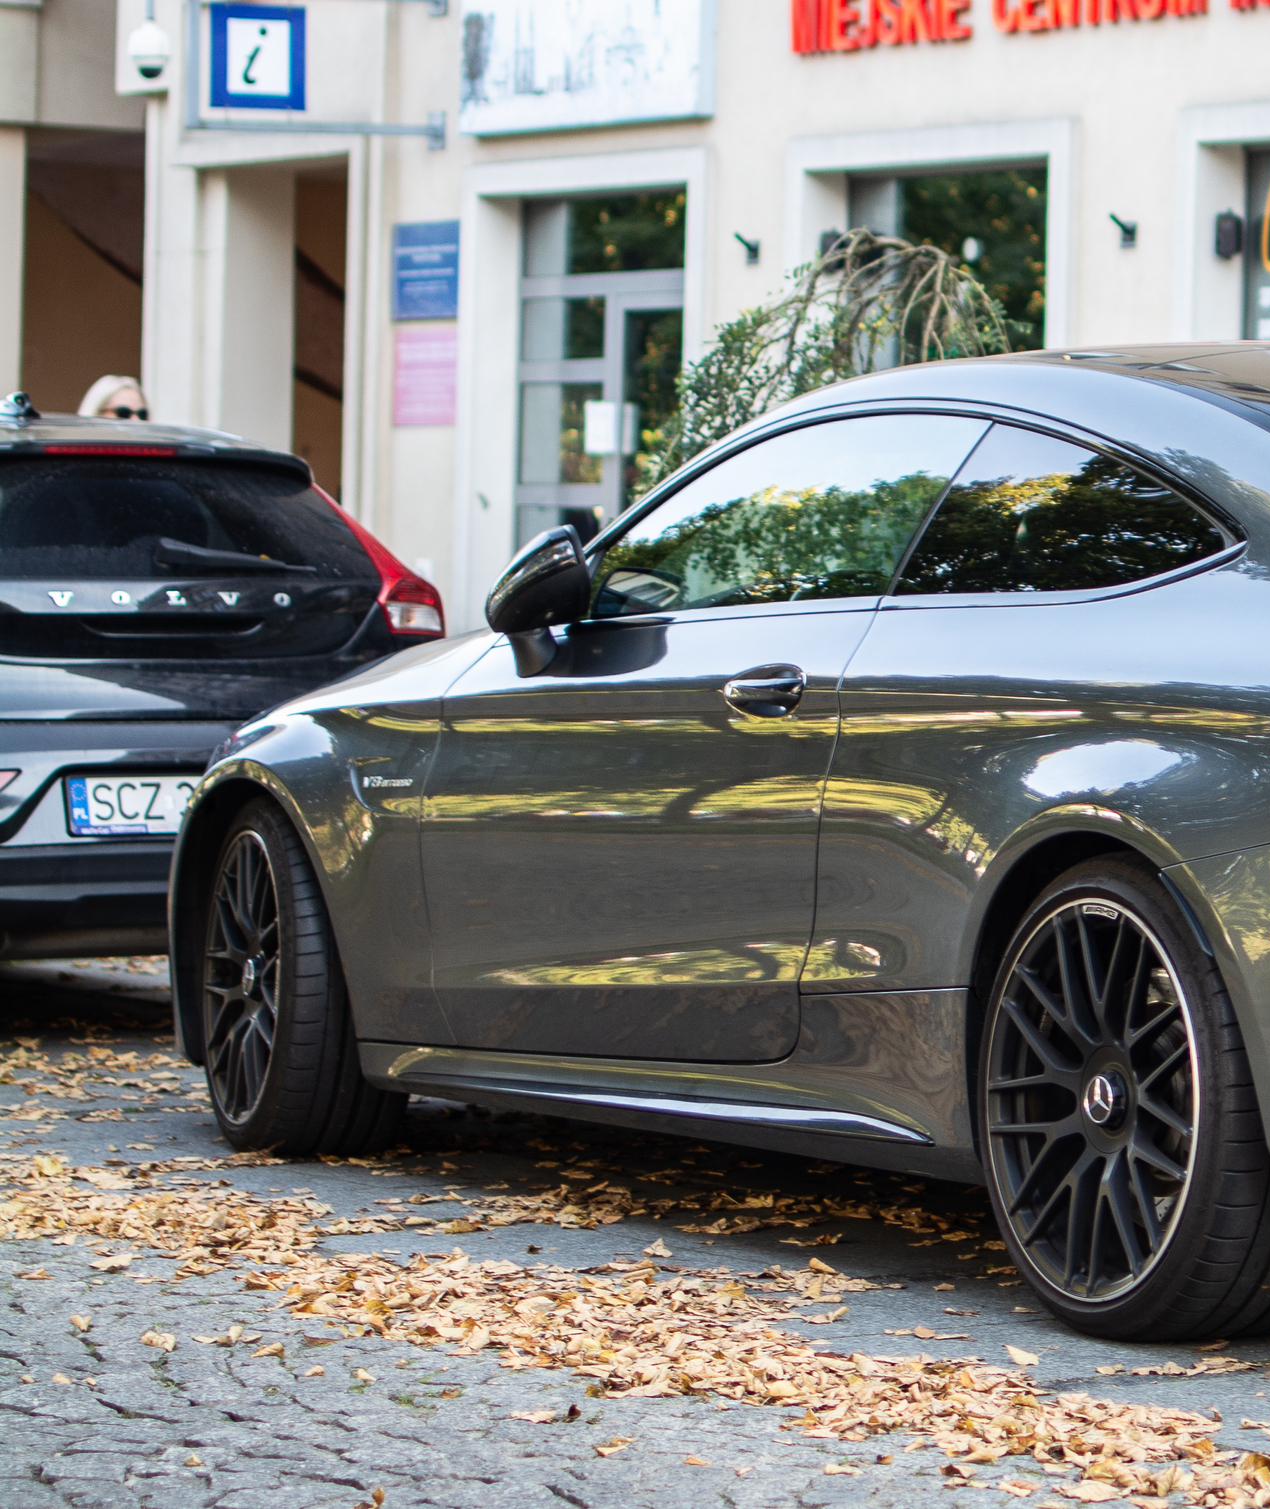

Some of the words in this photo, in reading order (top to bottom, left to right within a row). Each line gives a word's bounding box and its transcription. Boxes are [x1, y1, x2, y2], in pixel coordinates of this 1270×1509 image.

[790, 0, 972, 53] MIEJSKIE
[47, 590, 292, 608] VOLVO
[73, 807, 88, 820] PL
[92, 781, 165, 821] SCZ
